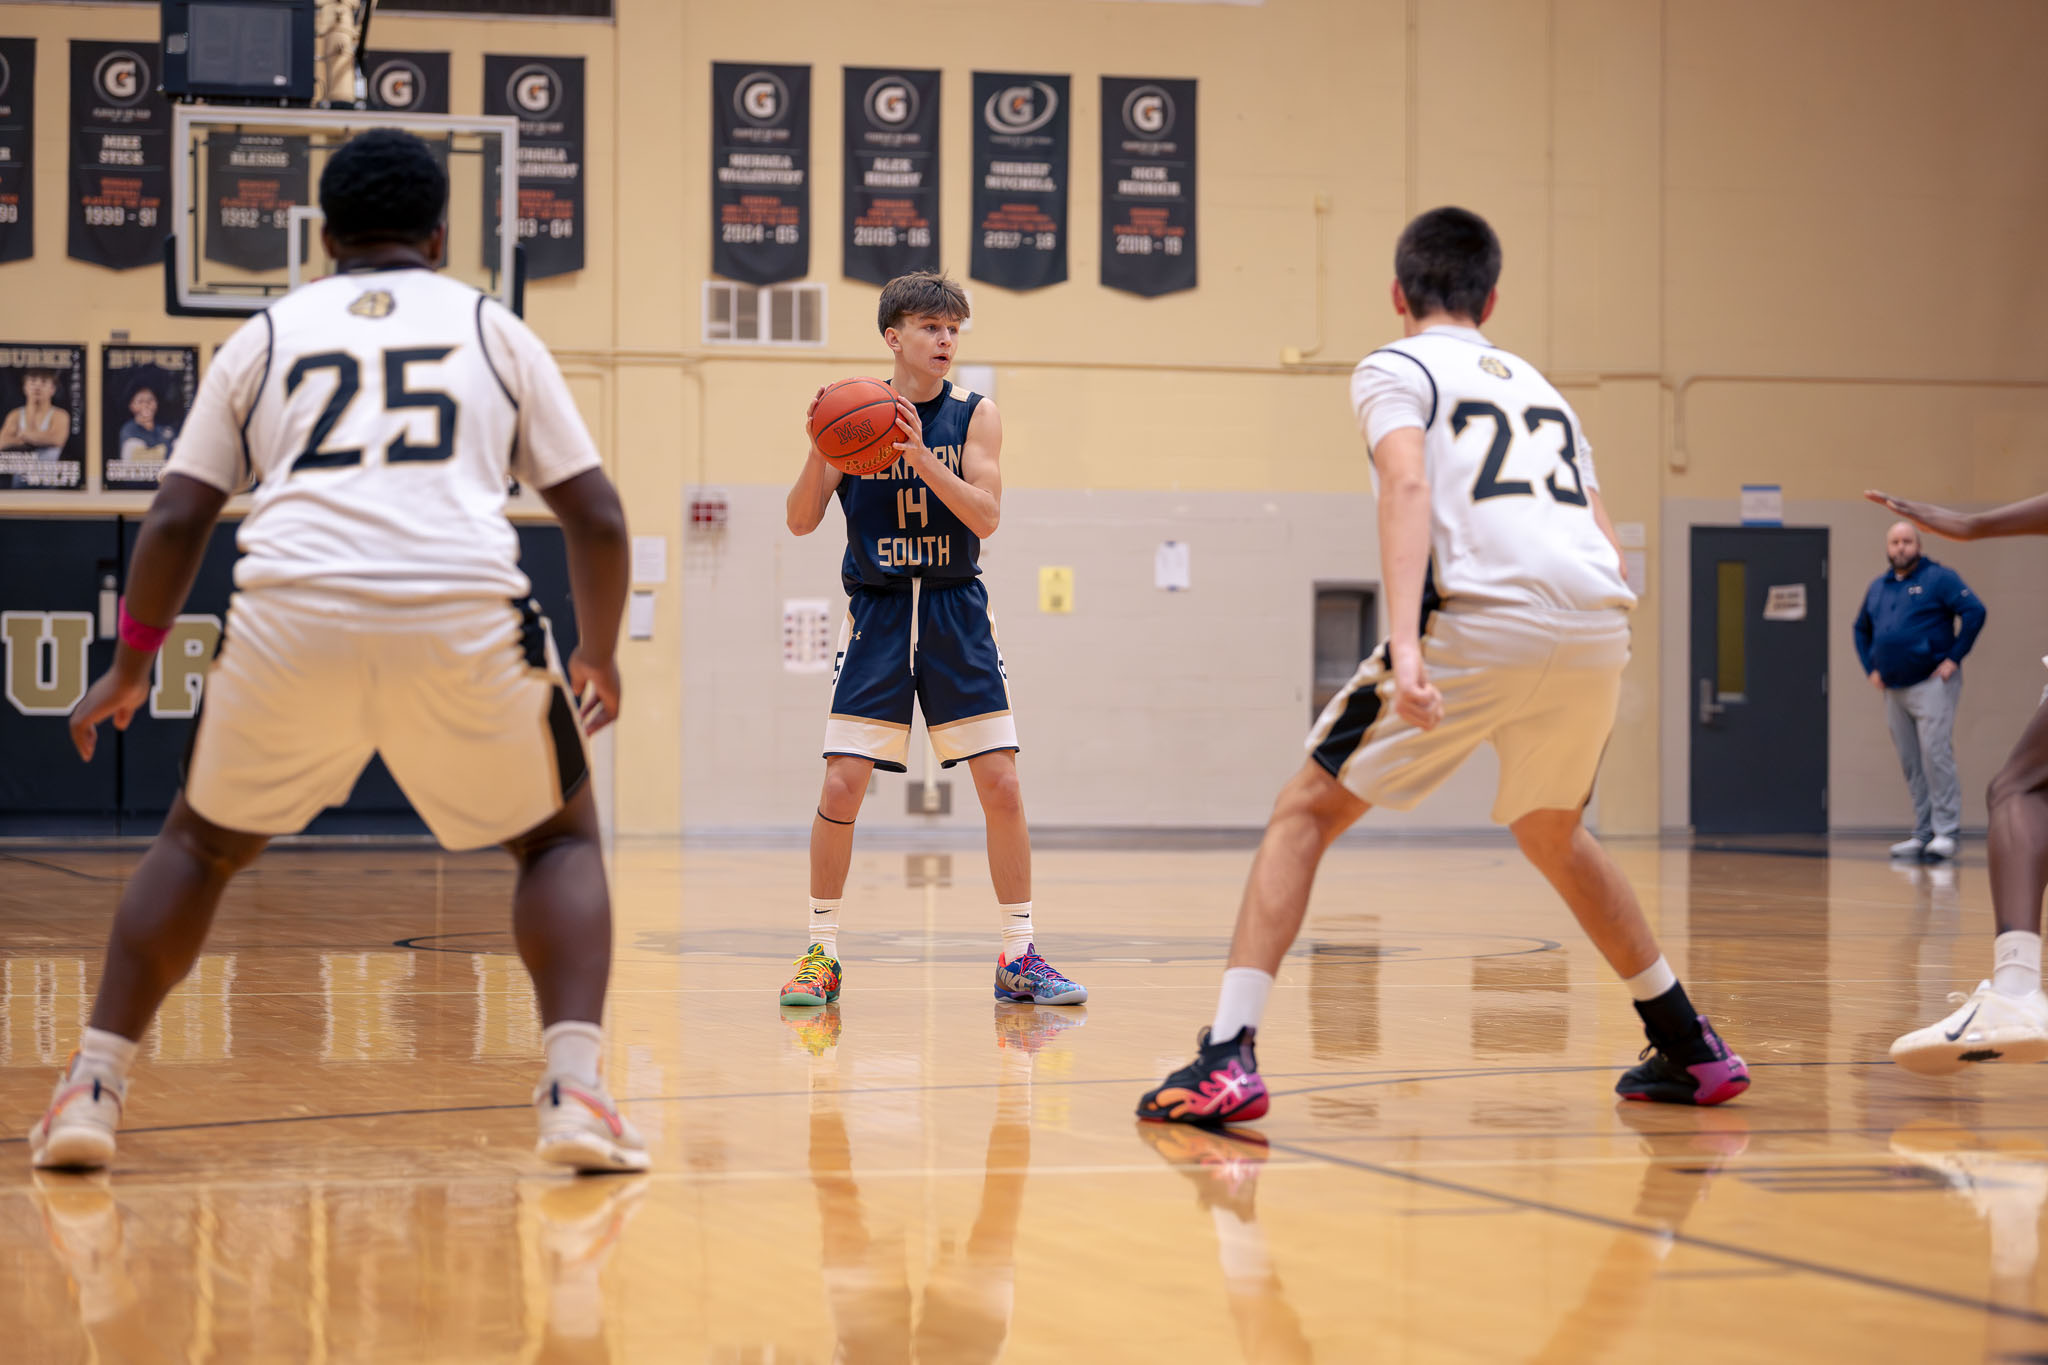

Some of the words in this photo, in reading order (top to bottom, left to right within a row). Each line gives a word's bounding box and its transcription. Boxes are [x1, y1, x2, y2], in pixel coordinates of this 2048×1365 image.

[102, 135, 141, 149] MIKE
[85, 205, 125, 226] 1990
[139, 207, 157, 227] 91
[284, 345, 462, 475] 25
[1449, 400, 1587, 507] 23
[897, 487, 928, 529] 14
[877, 534, 950, 567] SOUTH
